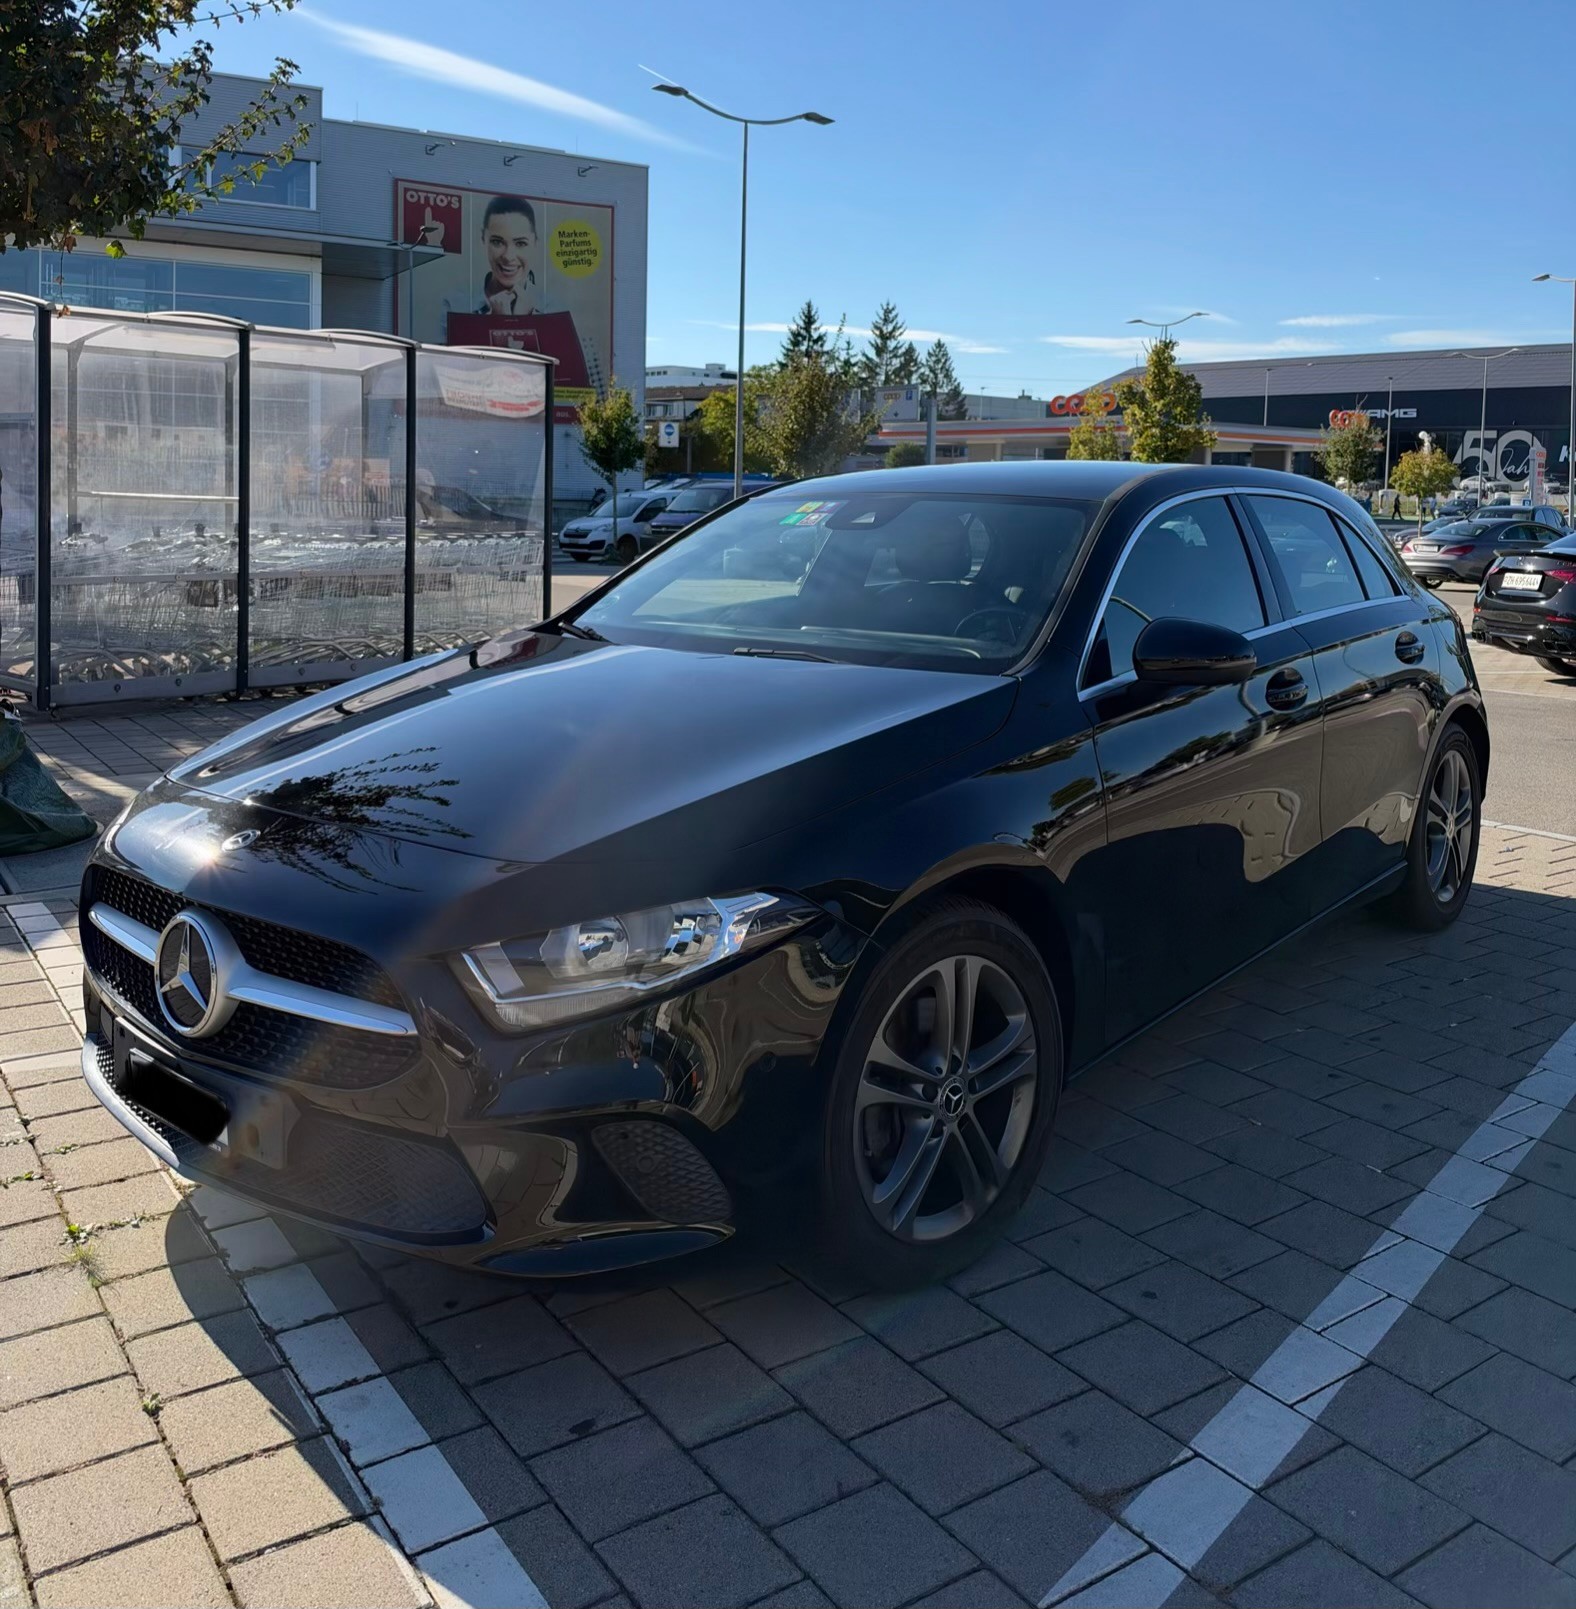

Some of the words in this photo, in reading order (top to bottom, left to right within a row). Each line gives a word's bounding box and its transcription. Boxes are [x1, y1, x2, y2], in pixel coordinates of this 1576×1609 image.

[406, 190, 460, 209] OTTO'S
[558, 230, 591, 238] Marken-
[560, 239, 592, 248] Parfums
[556, 248, 598, 258] einzigartig
[562, 257, 594, 269] günstig.
[1366, 408, 1417, 418] AMG
